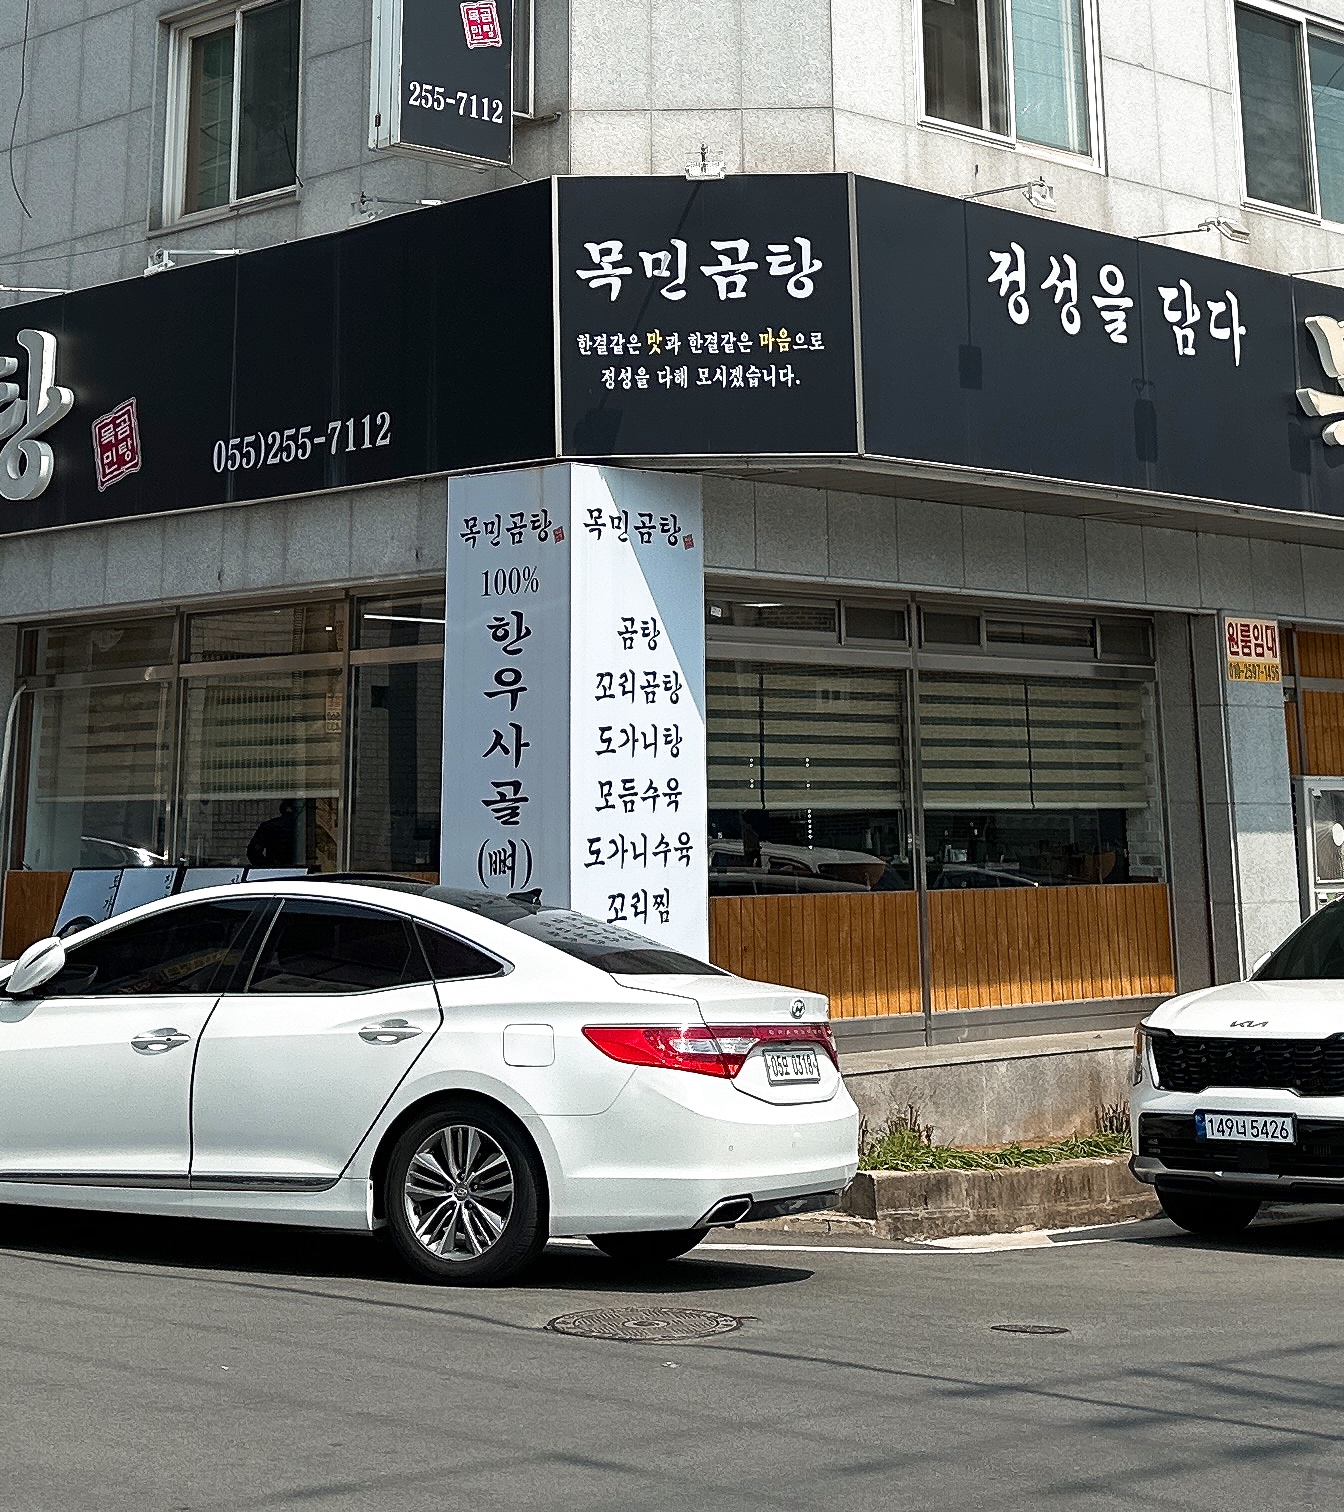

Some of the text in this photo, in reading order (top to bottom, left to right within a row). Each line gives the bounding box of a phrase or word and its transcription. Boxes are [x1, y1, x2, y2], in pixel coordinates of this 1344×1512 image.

[409, 81, 503, 123] 255-7112
[576, 237, 823, 301] 목민곰탕
[988, 242, 1246, 367] 정성을 담다
[577, 327, 825, 356] 한결같은 맛과 한결같은 마음으로
[601, 365, 801, 389] 정성을 다해 모시겠습니다.
[213, 411, 391, 472] 055)255-7112
[459, 509, 553, 548] 목민곰탕
[583, 508, 682, 547] 목민곰탕
[481, 566, 539, 597] 100%
[617, 616, 660, 651] 곰탕
[1227, 622, 1277, 658] 원룸임대
[595, 670, 683, 705] 꼬리곰탕
[595, 724, 683, 759] 도가니탕
[595, 778, 683, 813] 모듬수육
[584, 832, 694, 869] 도가니수육
[606, 888, 671, 924] 꼬리찜
[1207, 1118, 1289, 1140] 149너 5426
